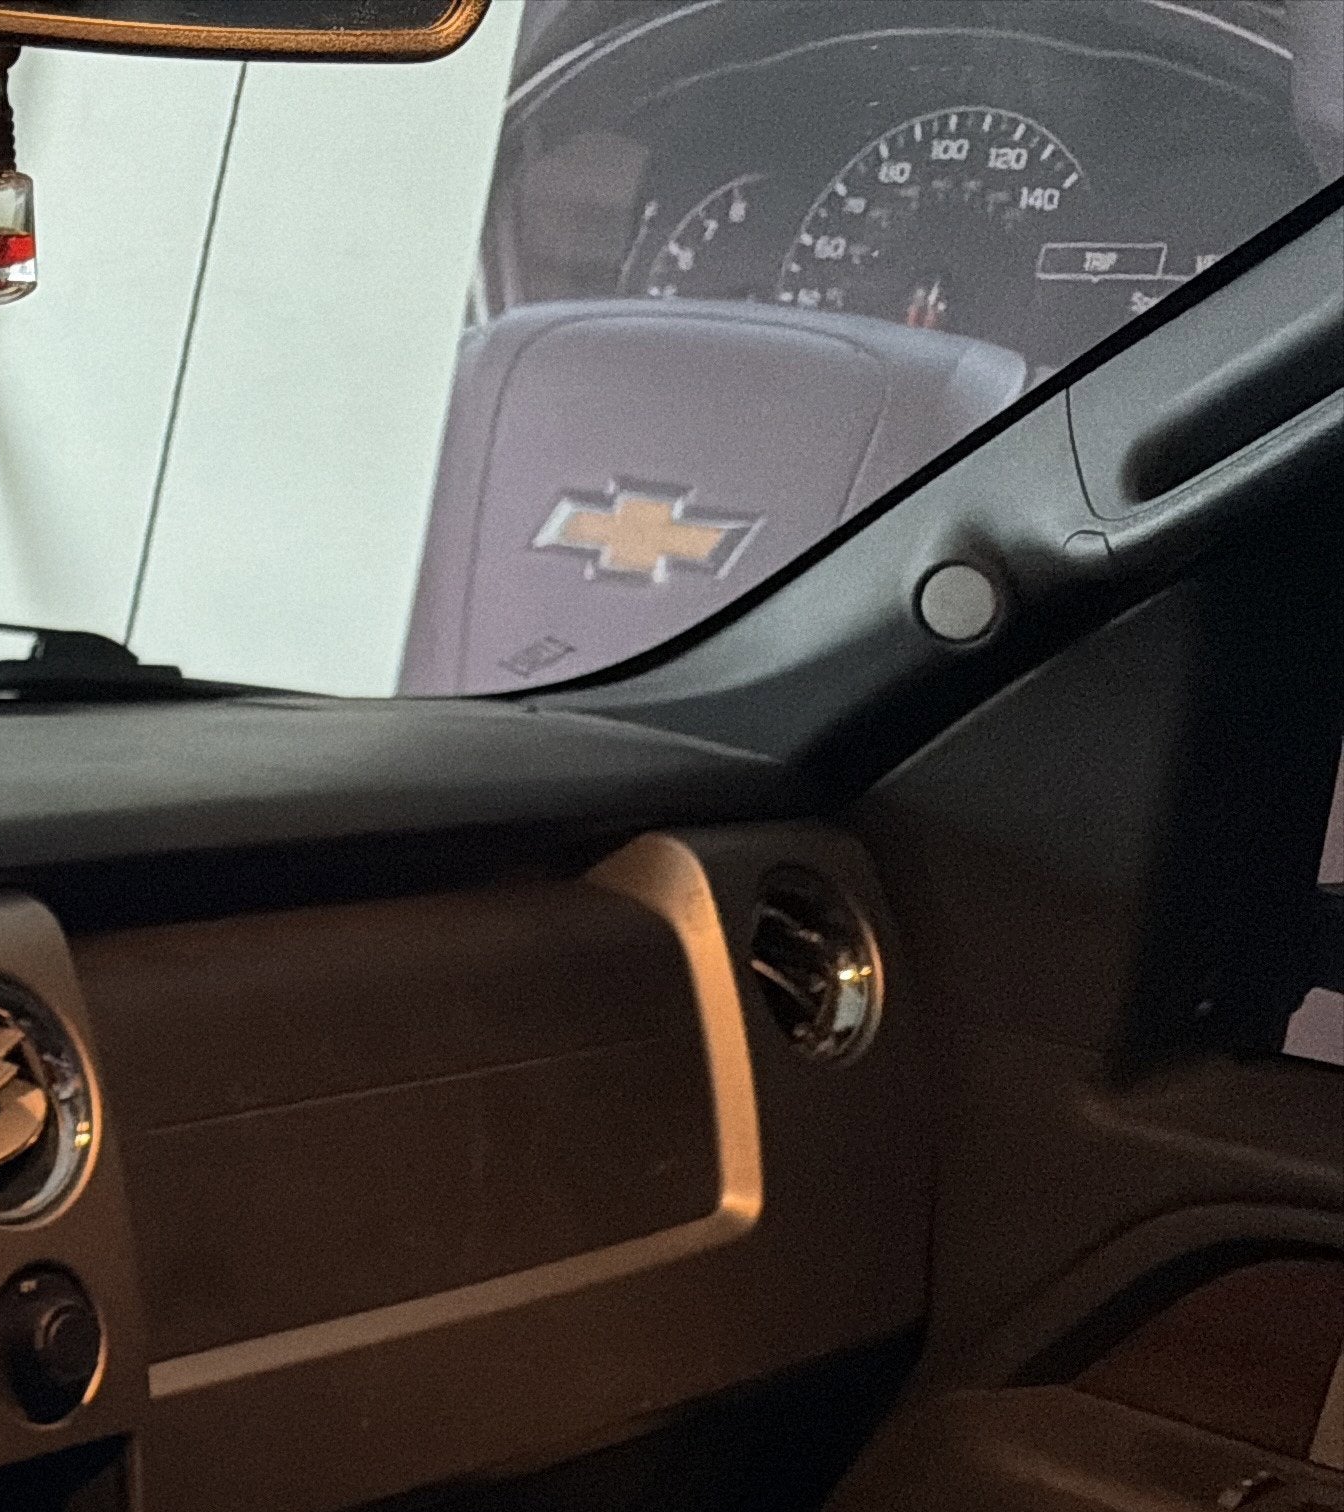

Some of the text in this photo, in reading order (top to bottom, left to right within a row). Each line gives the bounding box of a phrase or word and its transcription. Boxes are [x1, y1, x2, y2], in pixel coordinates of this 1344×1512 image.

[932, 138, 970, 161] 100
[988, 147, 1029, 171] 120
[1019, 186, 1060, 212] 140
